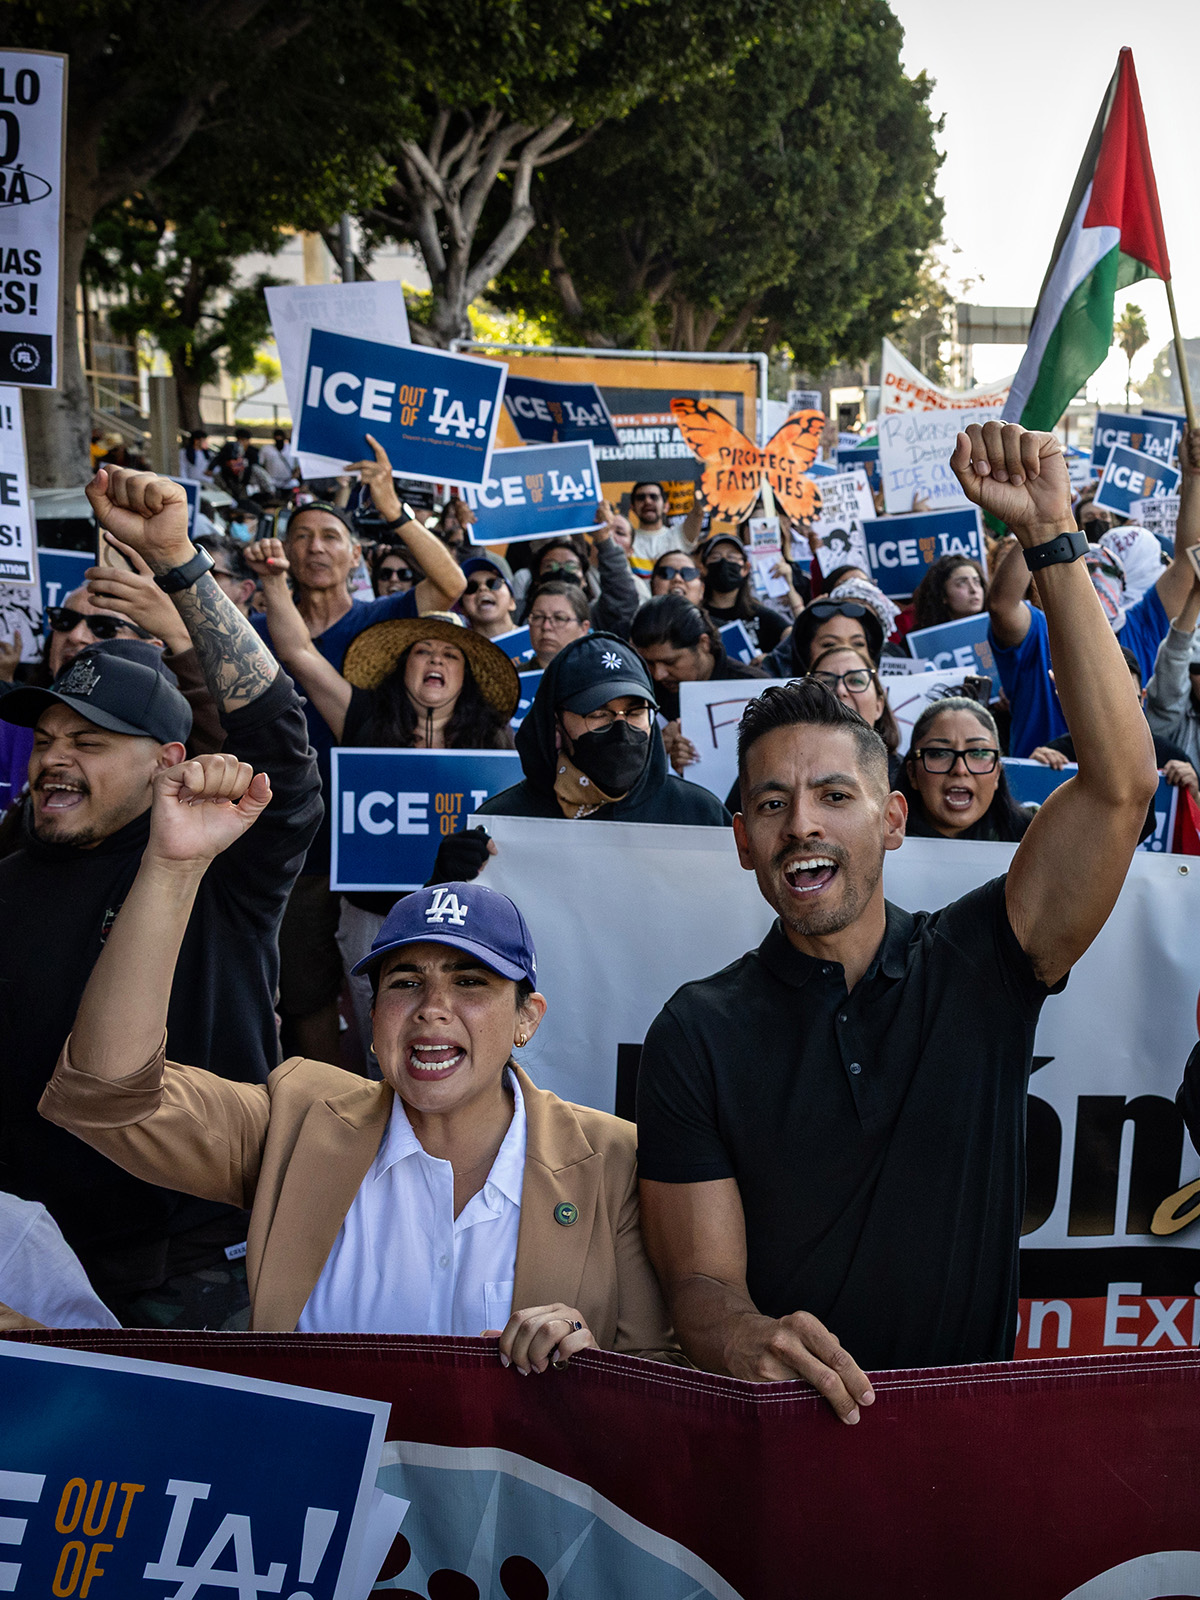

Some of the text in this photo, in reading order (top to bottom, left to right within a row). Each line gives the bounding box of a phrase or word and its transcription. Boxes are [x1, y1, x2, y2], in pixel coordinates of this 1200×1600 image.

[0, 247, 42, 276] AS
[0, 280, 38, 316] S!
[306, 365, 492, 440] ICE OUT OF LA!
[504, 394, 553, 422] ICE
[562, 401, 607, 427] LA!
[1095, 427, 1130, 449] ICE
[1143, 433, 1170, 457] LA!
[718, 447, 795, 474] PROTECT
[525, 474, 544, 490] OUT
[547, 469, 594, 502] LA!
[716, 470, 803, 499] FAMILIES
[889, 465, 924, 492] ICE
[1106, 462, 1146, 494] ICE
[531, 488, 543, 504] OF
[868, 539, 919, 569] ICE
[342, 791, 430, 835] ICE
[435, 792, 464, 813] OUT
[440, 815, 458, 836] OF
[425, 888, 468, 926] LA
[54, 1477, 145, 1538] OUT
[143, 1478, 339, 1600] LA!
[52, 1540, 113, 1599] OF
